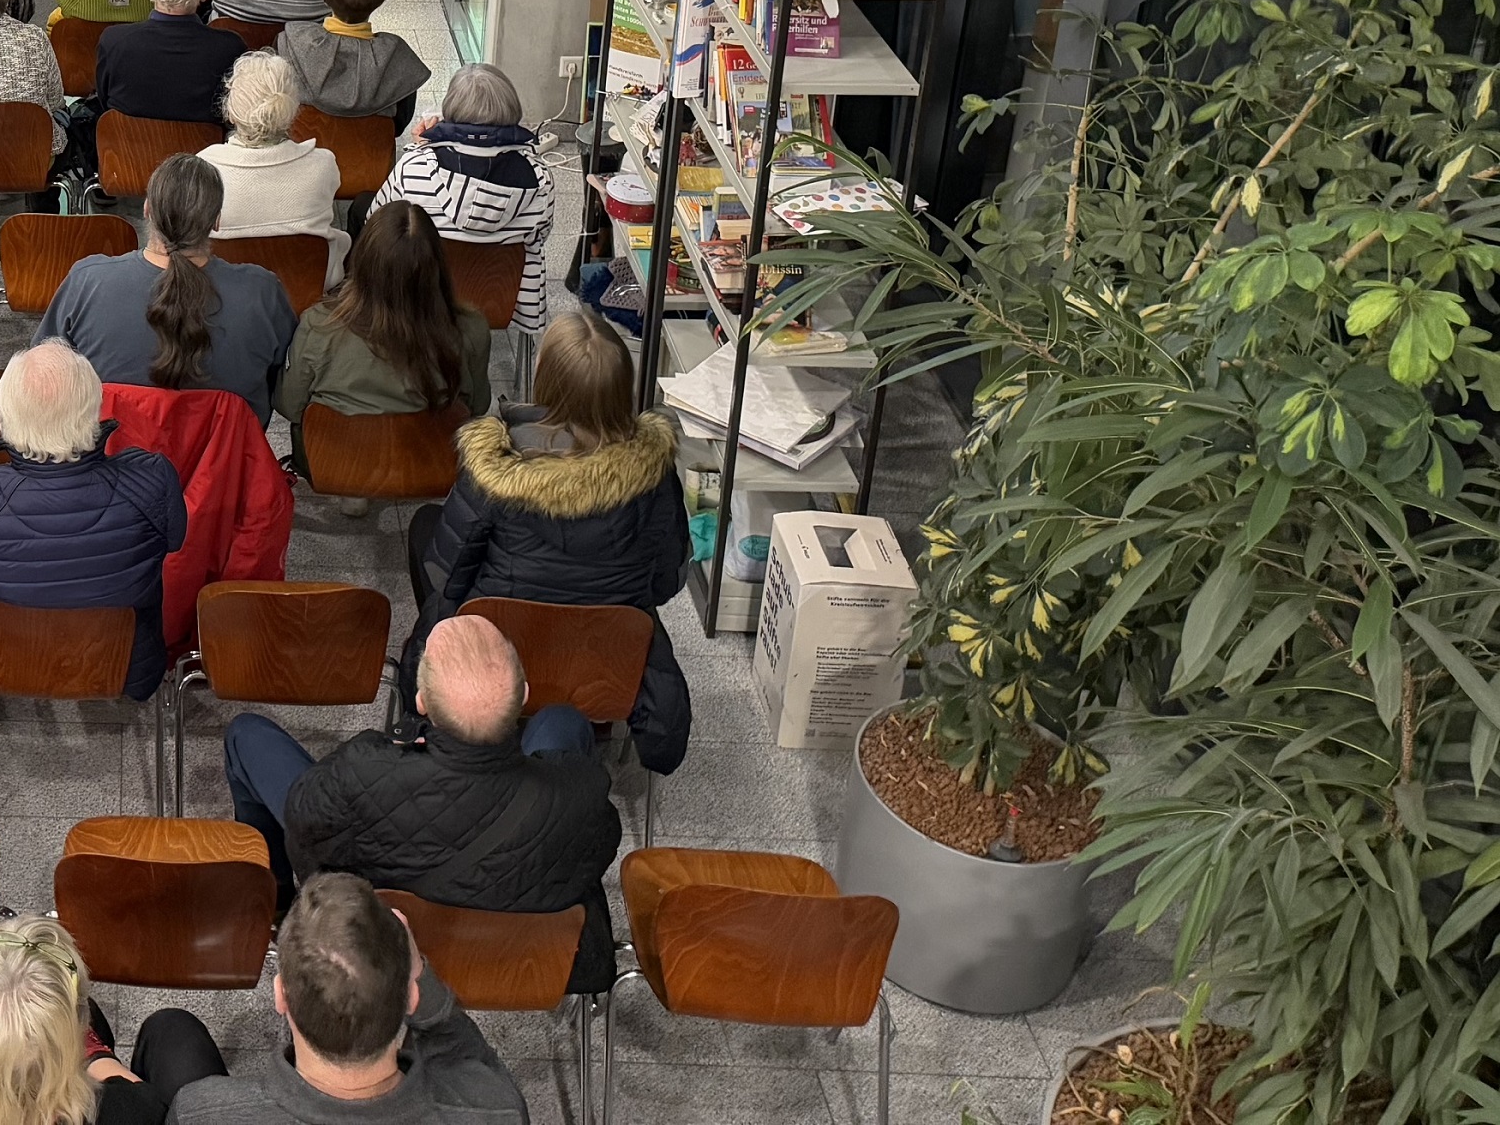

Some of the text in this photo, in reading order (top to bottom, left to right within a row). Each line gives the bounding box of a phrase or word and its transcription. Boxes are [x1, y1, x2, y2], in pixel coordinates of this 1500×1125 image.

[810, 15, 828, 25] und
[732, 59, 745, 70] 12
[732, 74, 765, 84] Entdec
